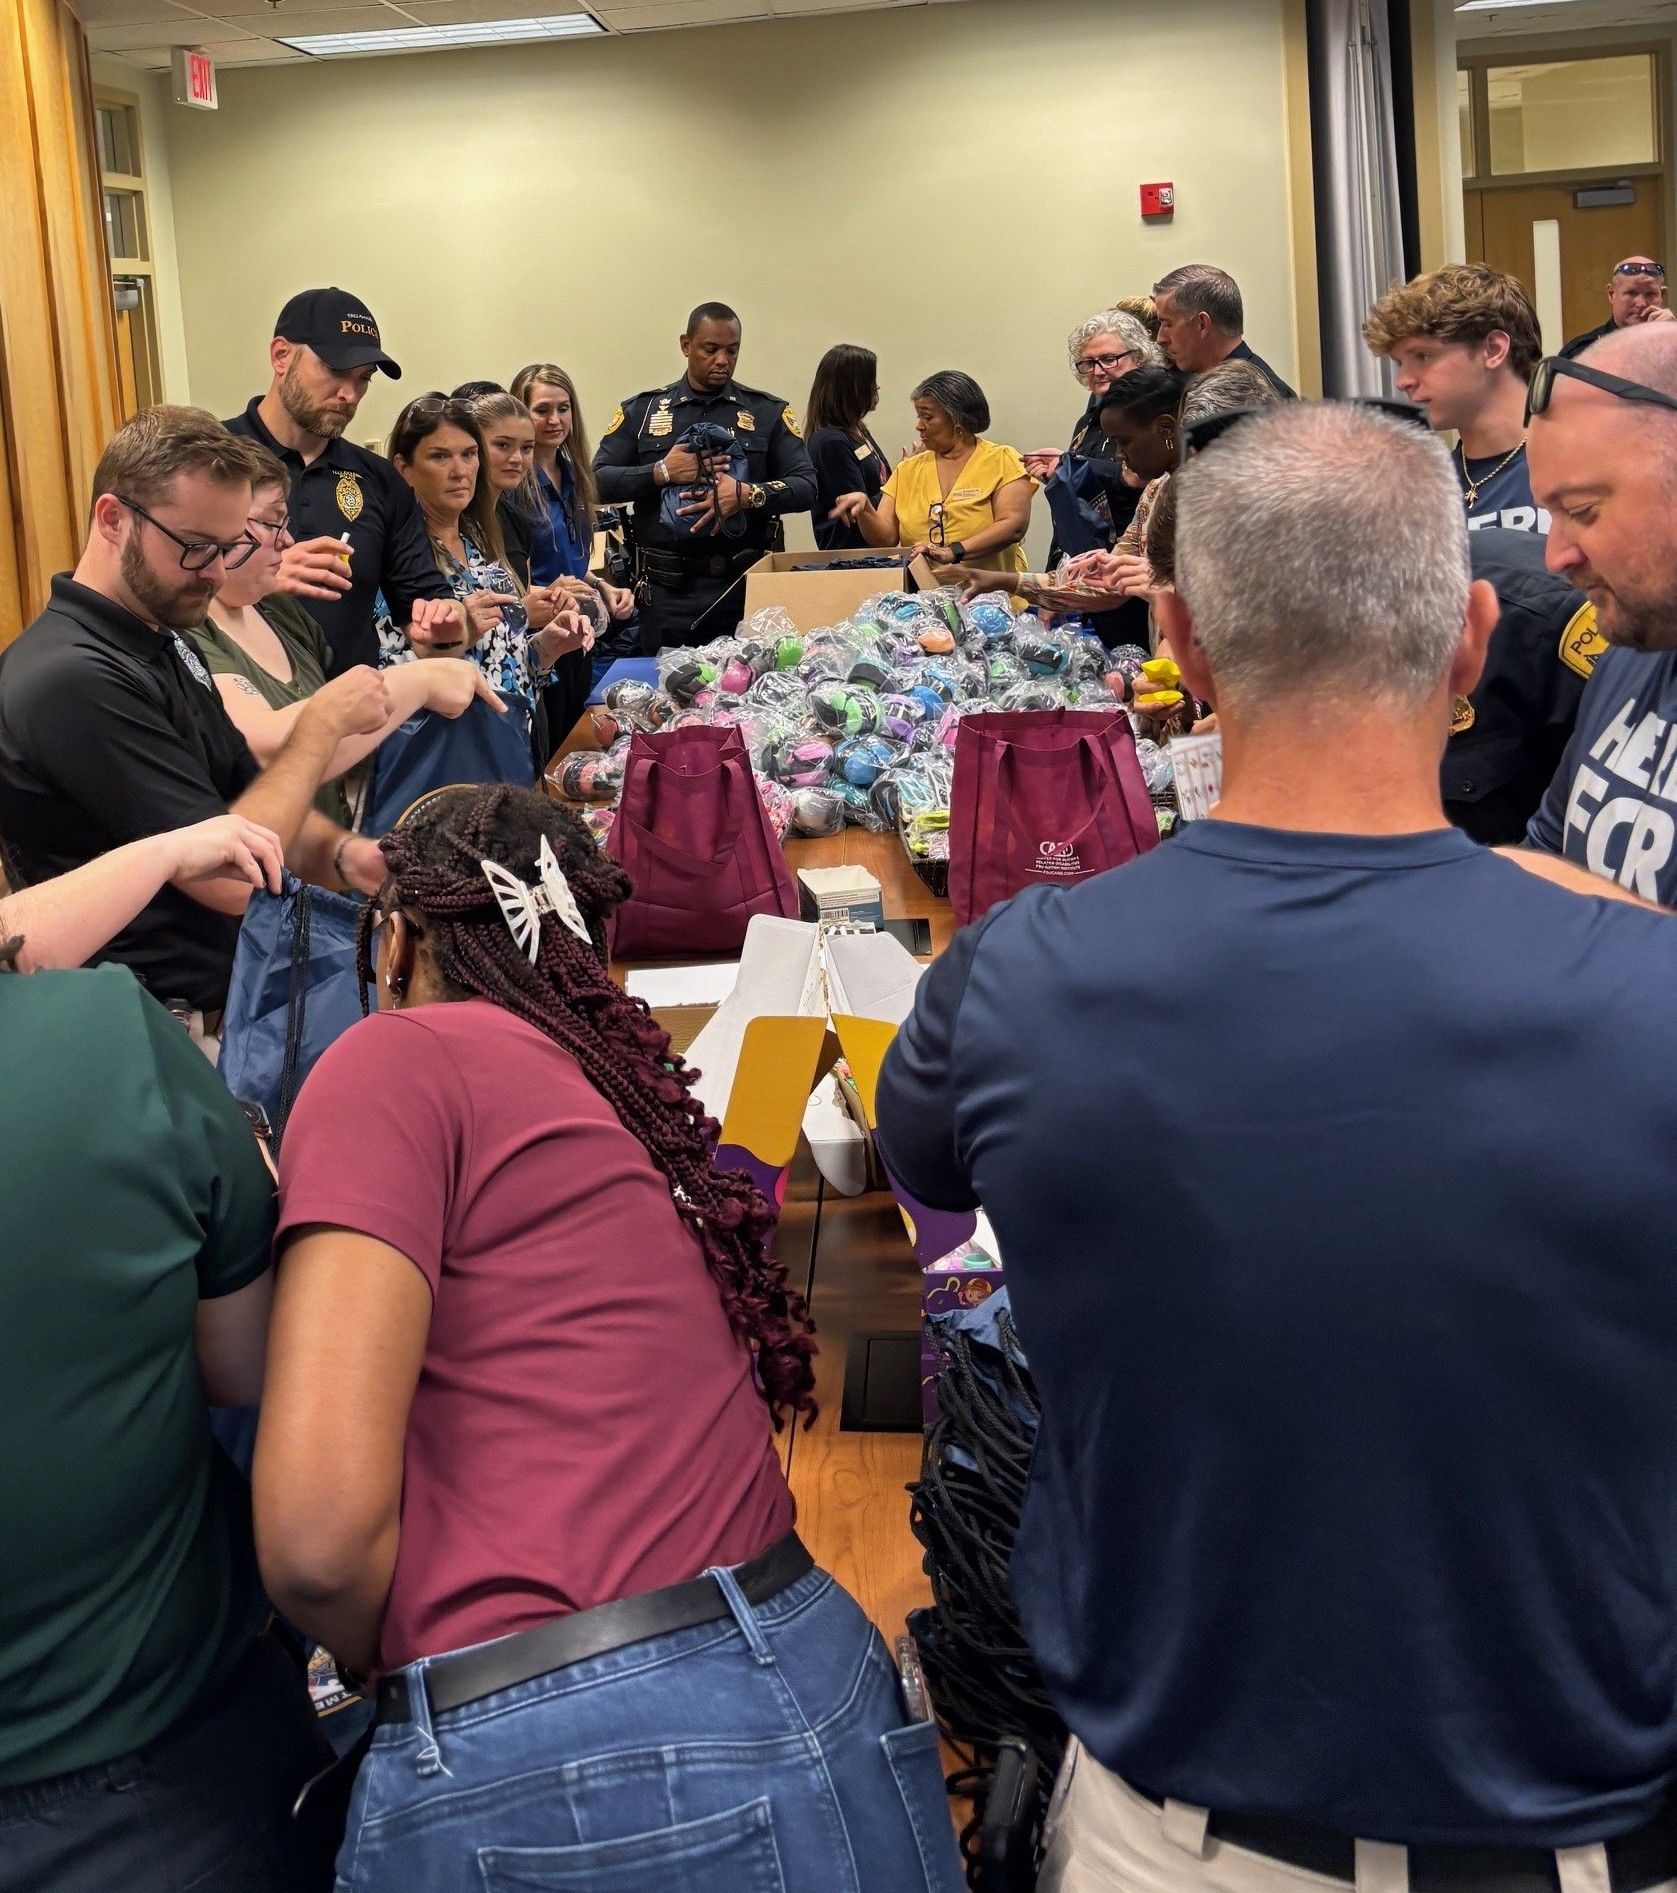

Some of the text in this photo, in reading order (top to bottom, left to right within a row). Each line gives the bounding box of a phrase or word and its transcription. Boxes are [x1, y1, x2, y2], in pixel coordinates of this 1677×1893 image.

[190, 54, 213, 101] EXIT
[340, 320, 379, 340] POLIC
[1569, 627, 1599, 655] POL
